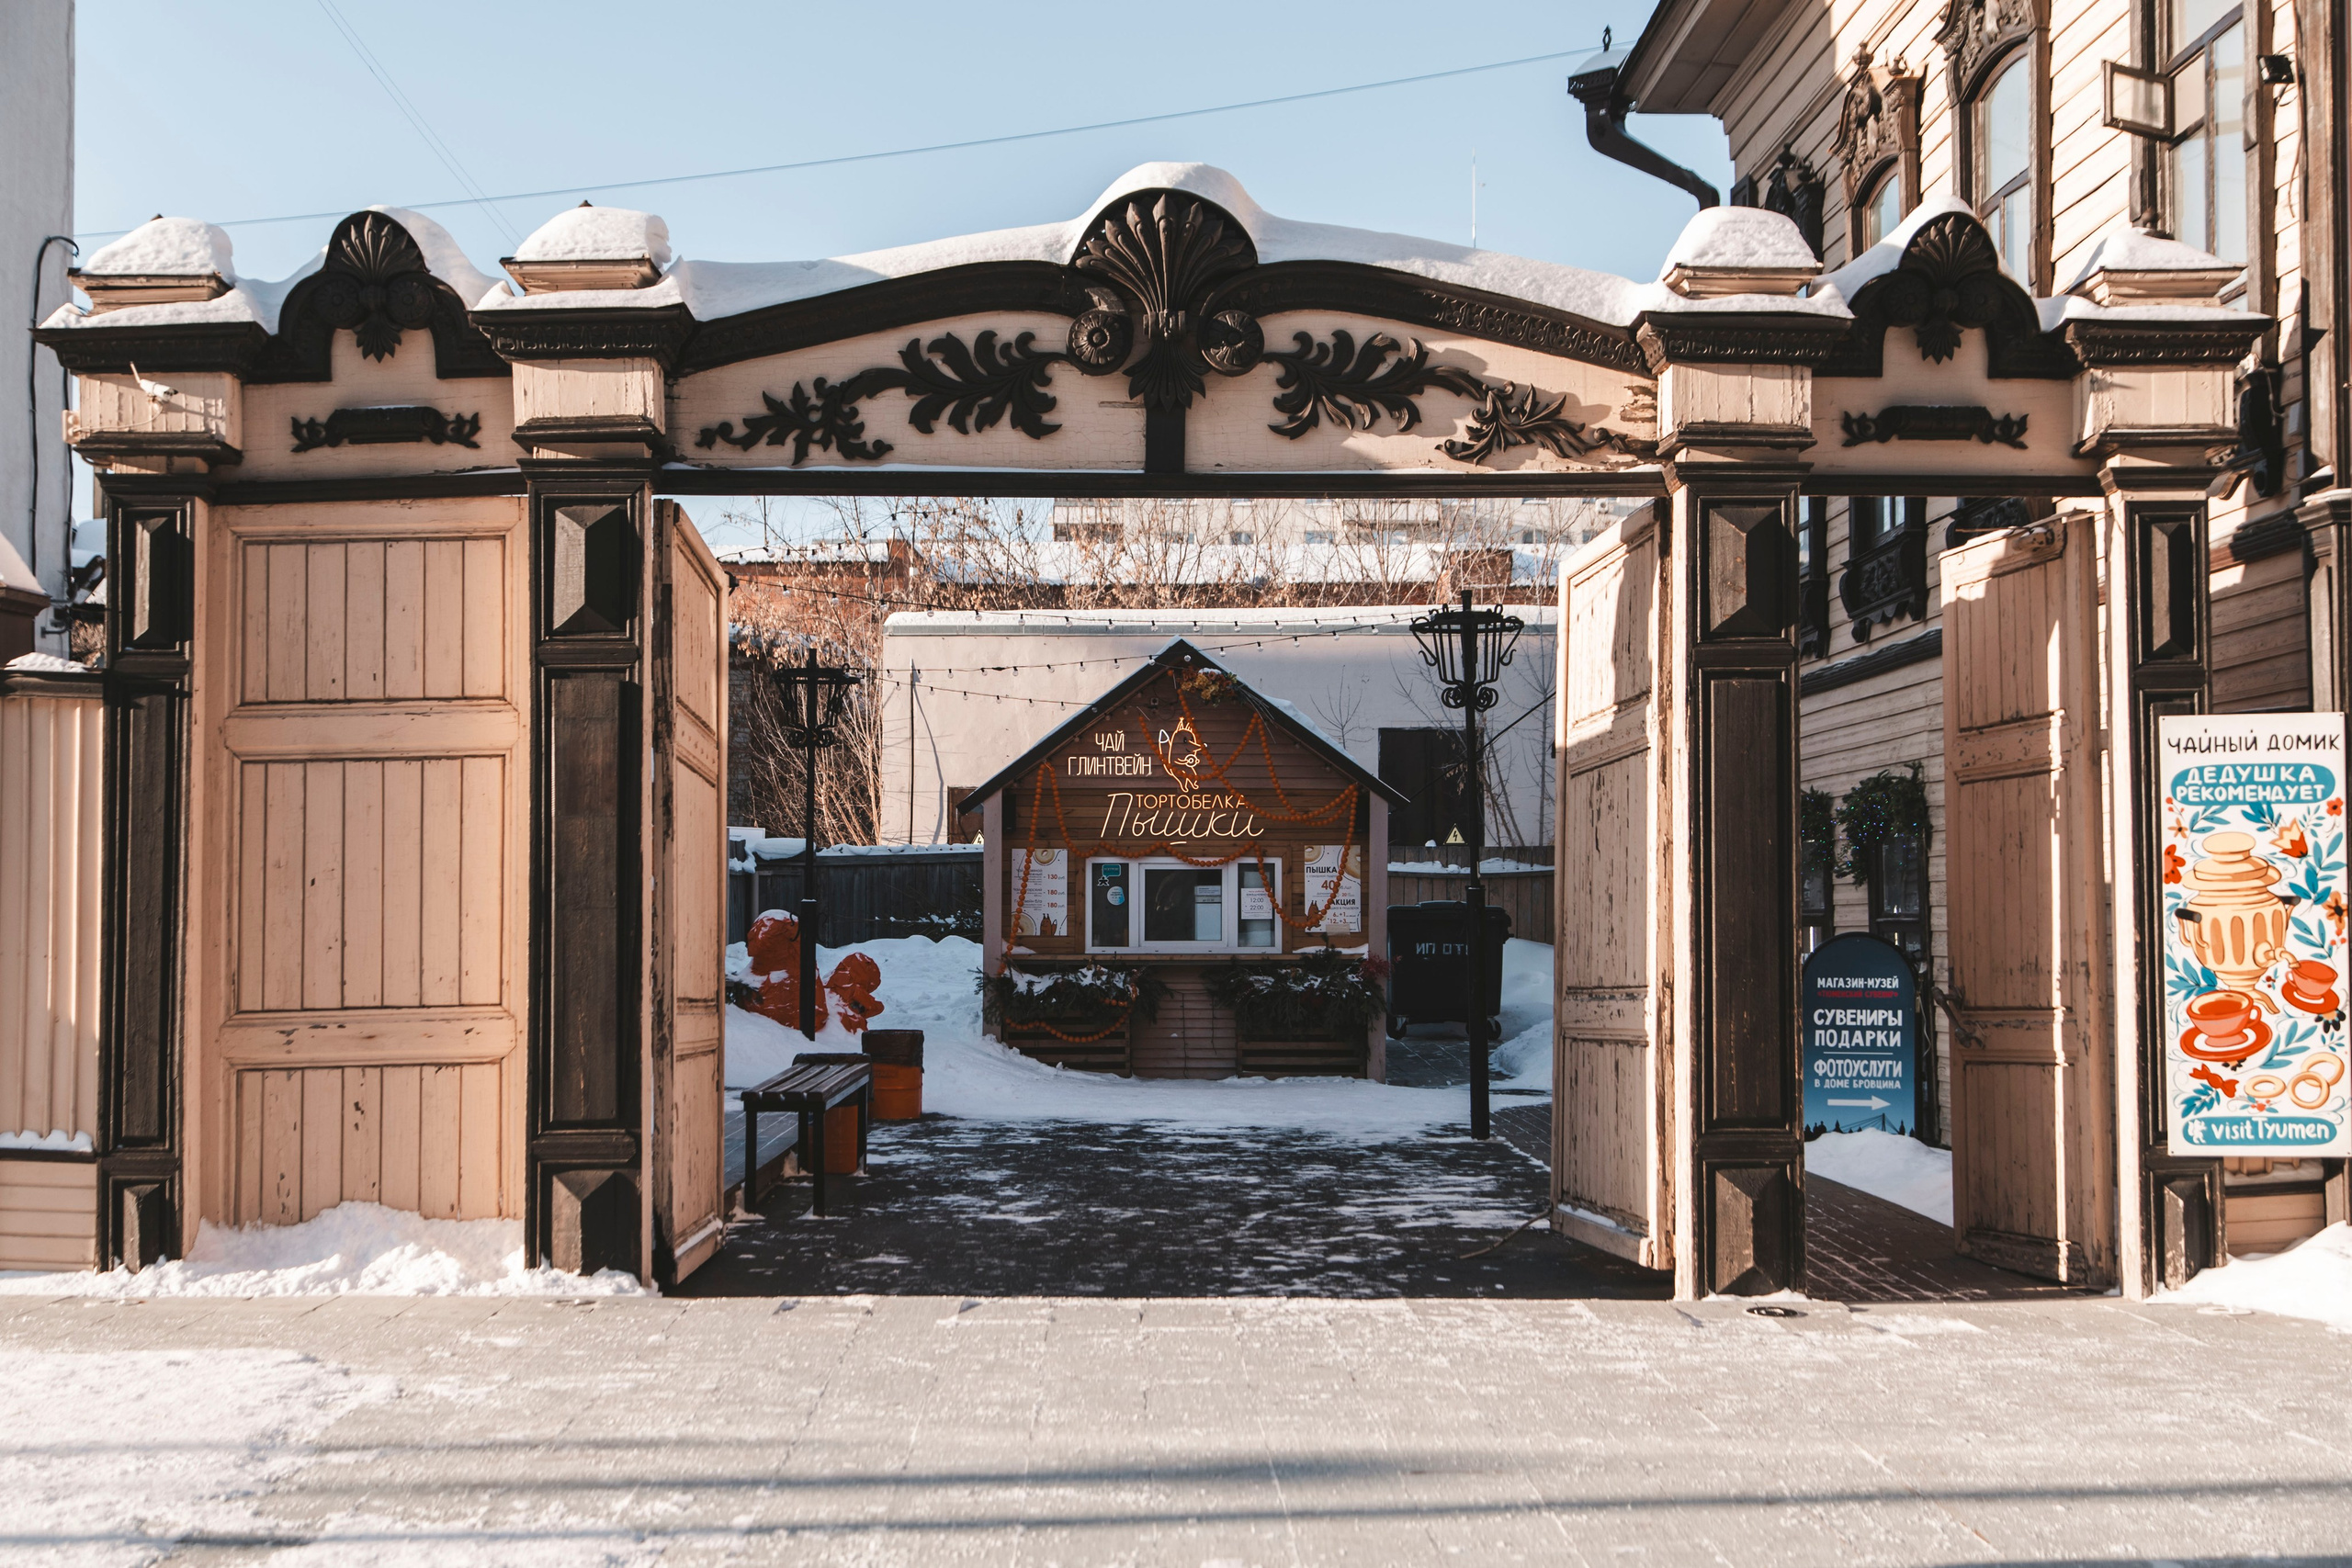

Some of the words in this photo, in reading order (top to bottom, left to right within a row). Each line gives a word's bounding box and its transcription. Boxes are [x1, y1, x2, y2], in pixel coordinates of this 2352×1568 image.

[1095, 730, 1125, 751] ЧАЙ
[2167, 728, 2258, 754] ЧАЙНЫЙ
[2267, 734, 2340, 751] ДОМИК
[1068, 753, 1152, 775] ГЛИНТВЕЙН
[2185, 765, 2316, 785] ДЕДУШКА
[1136, 794, 1248, 809] ТОРТОБЕЛКА
[2176, 784, 2325, 802] РЕКОМЕНДУЕТ
[1101, 793, 1264, 838] Пышки
[1321, 880, 1335, 890] 40
[1416, 942, 1435, 954] ИП
[1817, 976, 1899, 988] МАГАЗИН-МУЗЕЙ
[1814, 1009, 1902, 1027] СУВЕНИРЫ
[1815, 1030, 1901, 1048] ПОДАРКИ
[1814, 1058, 1902, 1077] ФОТОУСЛУГИ
[1815, 1078, 1820, 1088] В
[1824, 1078, 1849, 1089] ДОМЕ
[1852, 1079, 1901, 1089] БРОВЦИНА
